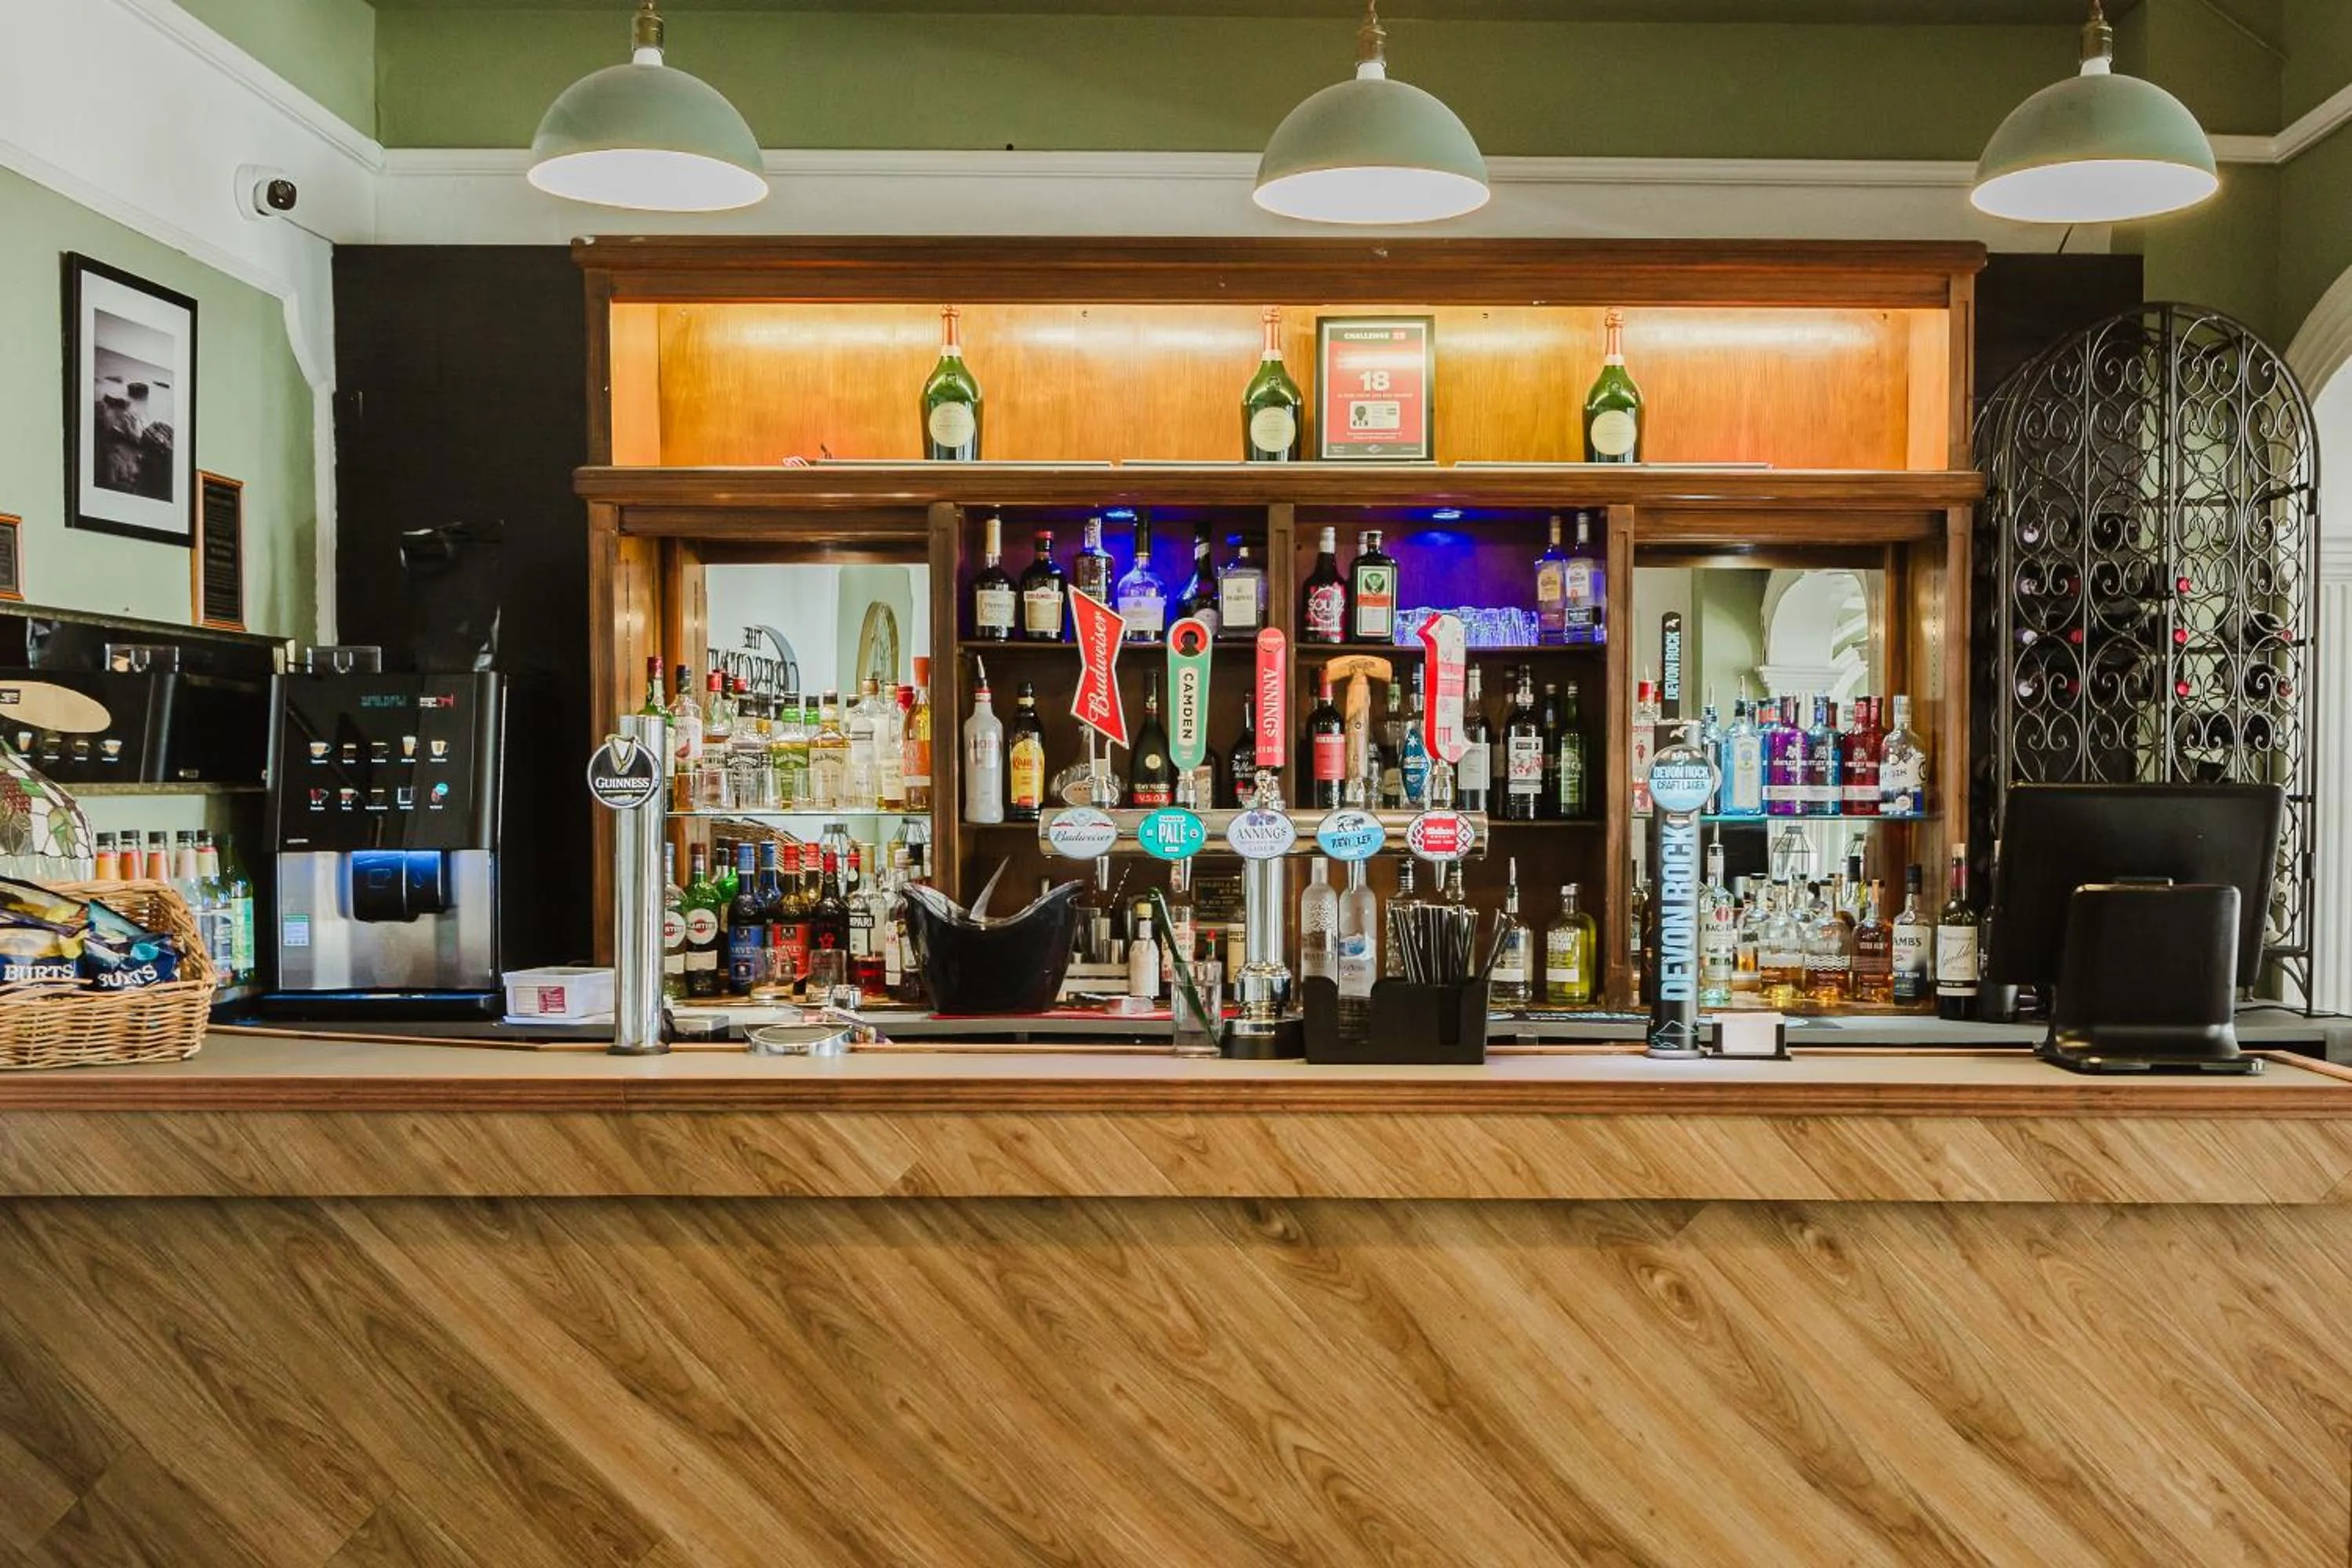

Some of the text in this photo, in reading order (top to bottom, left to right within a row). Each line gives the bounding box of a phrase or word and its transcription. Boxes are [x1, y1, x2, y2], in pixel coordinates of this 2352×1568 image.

[1359, 370, 1390, 391] 18
[1087, 611, 1110, 722] Budweiser
[1664, 631, 1681, 700] DEVON ROCK
[1182, 673, 1194, 739] CAMDEN
[1263, 667, 1279, 738] ANNINGS
[595, 777, 651, 789] GUINNESS
[1653, 766, 1709, 779] DEVON ROCK
[1657, 780, 1706, 790] CRAFT LAGER
[1054, 829, 1110, 842] Budweiser
[1158, 823, 1186, 844] PALE
[1236, 827, 1287, 840] ANNINGS
[1661, 825, 1696, 1001] DEVON ROCK
[4, 964, 75, 981] BURTS
